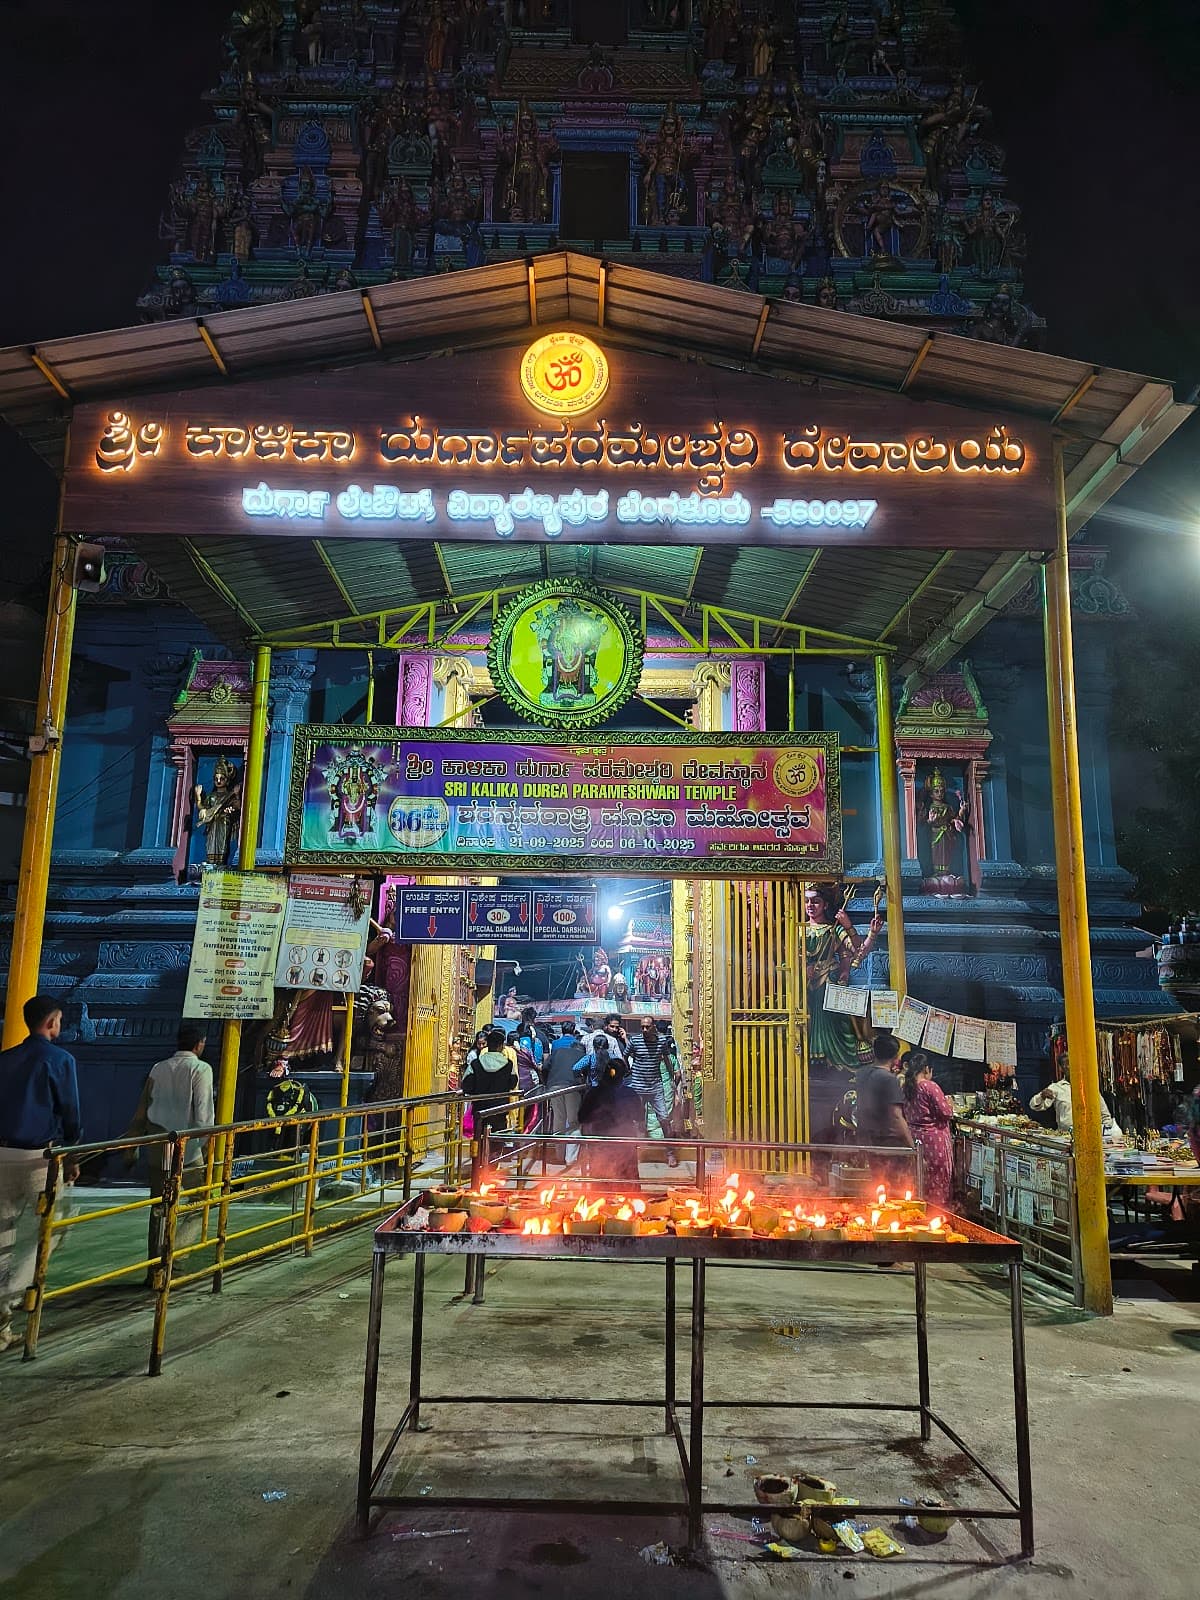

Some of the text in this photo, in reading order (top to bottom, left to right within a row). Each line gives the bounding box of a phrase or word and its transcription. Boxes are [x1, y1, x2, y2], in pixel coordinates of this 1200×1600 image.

[95, 411, 163, 473] ಶ್ರೀ
[186, 423, 356, 463] ಕಾಳಿಕಾ
[783, 425, 1026, 474] ದೇವಾಲಯ
[242, 481, 330, 519] ದುರ್ಗಾ
[447, 487, 610, 537] ವಿದ್ಯಾರಣ್ಯಪುರ
[617, 489, 752, 526] ಬೆಂಗಳೂರು
[406, 753, 434, 780] ಶ್ರೀ
[441, 760, 508, 777] ಕಾಳಿಕಾ
[516, 757, 574, 777] ದುರ್ಗಾ
[583, 758, 674, 785] ಪರಮೇಶ್ವರಿ
[681, 759, 768, 789] ದೇವಸ್ಥಾನ
[444, 782, 737, 800] SRI KALIKA DURGA PARAMESHWARI TEMPLE
[456, 799, 812, 839] ಶರನ್ನವರಾತ್ರಿ ಪೂಜಾ ಮಹೋತ್ಸವ
[456, 835, 496, 848] ದಿನಾಂಕ
[509, 836, 585, 849] 21-09-2025
[620, 838, 696, 851] 06-10-2025
[404, 906, 460, 914] FREE ENTRY
[468, 925, 528, 934] SPECIAL DARSHANA
